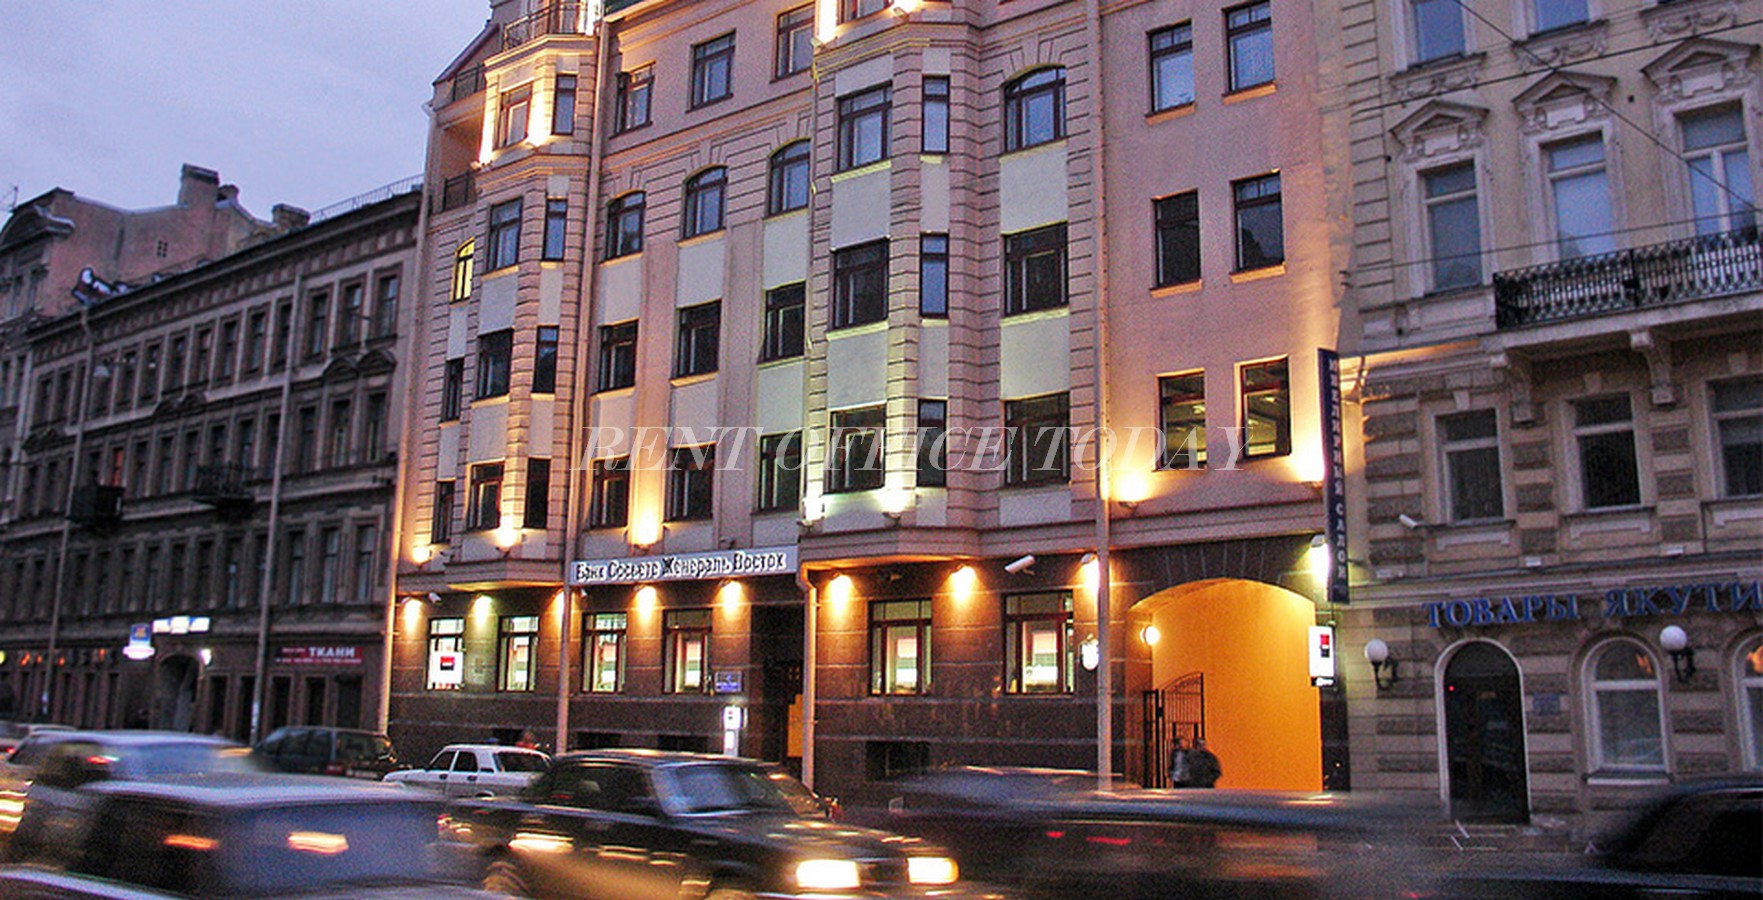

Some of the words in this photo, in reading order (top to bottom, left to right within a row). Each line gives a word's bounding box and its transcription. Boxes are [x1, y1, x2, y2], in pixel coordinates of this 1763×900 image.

[1335, 503, 1346, 579] САЛОН
[576, 562, 607, 582] Банк
[661, 556, 732, 579] Женераль
[733, 551, 786, 573] Восток
[1422, 593, 1580, 628] ТОВАРЫ
[308, 645, 355, 658] ТКАНИ
